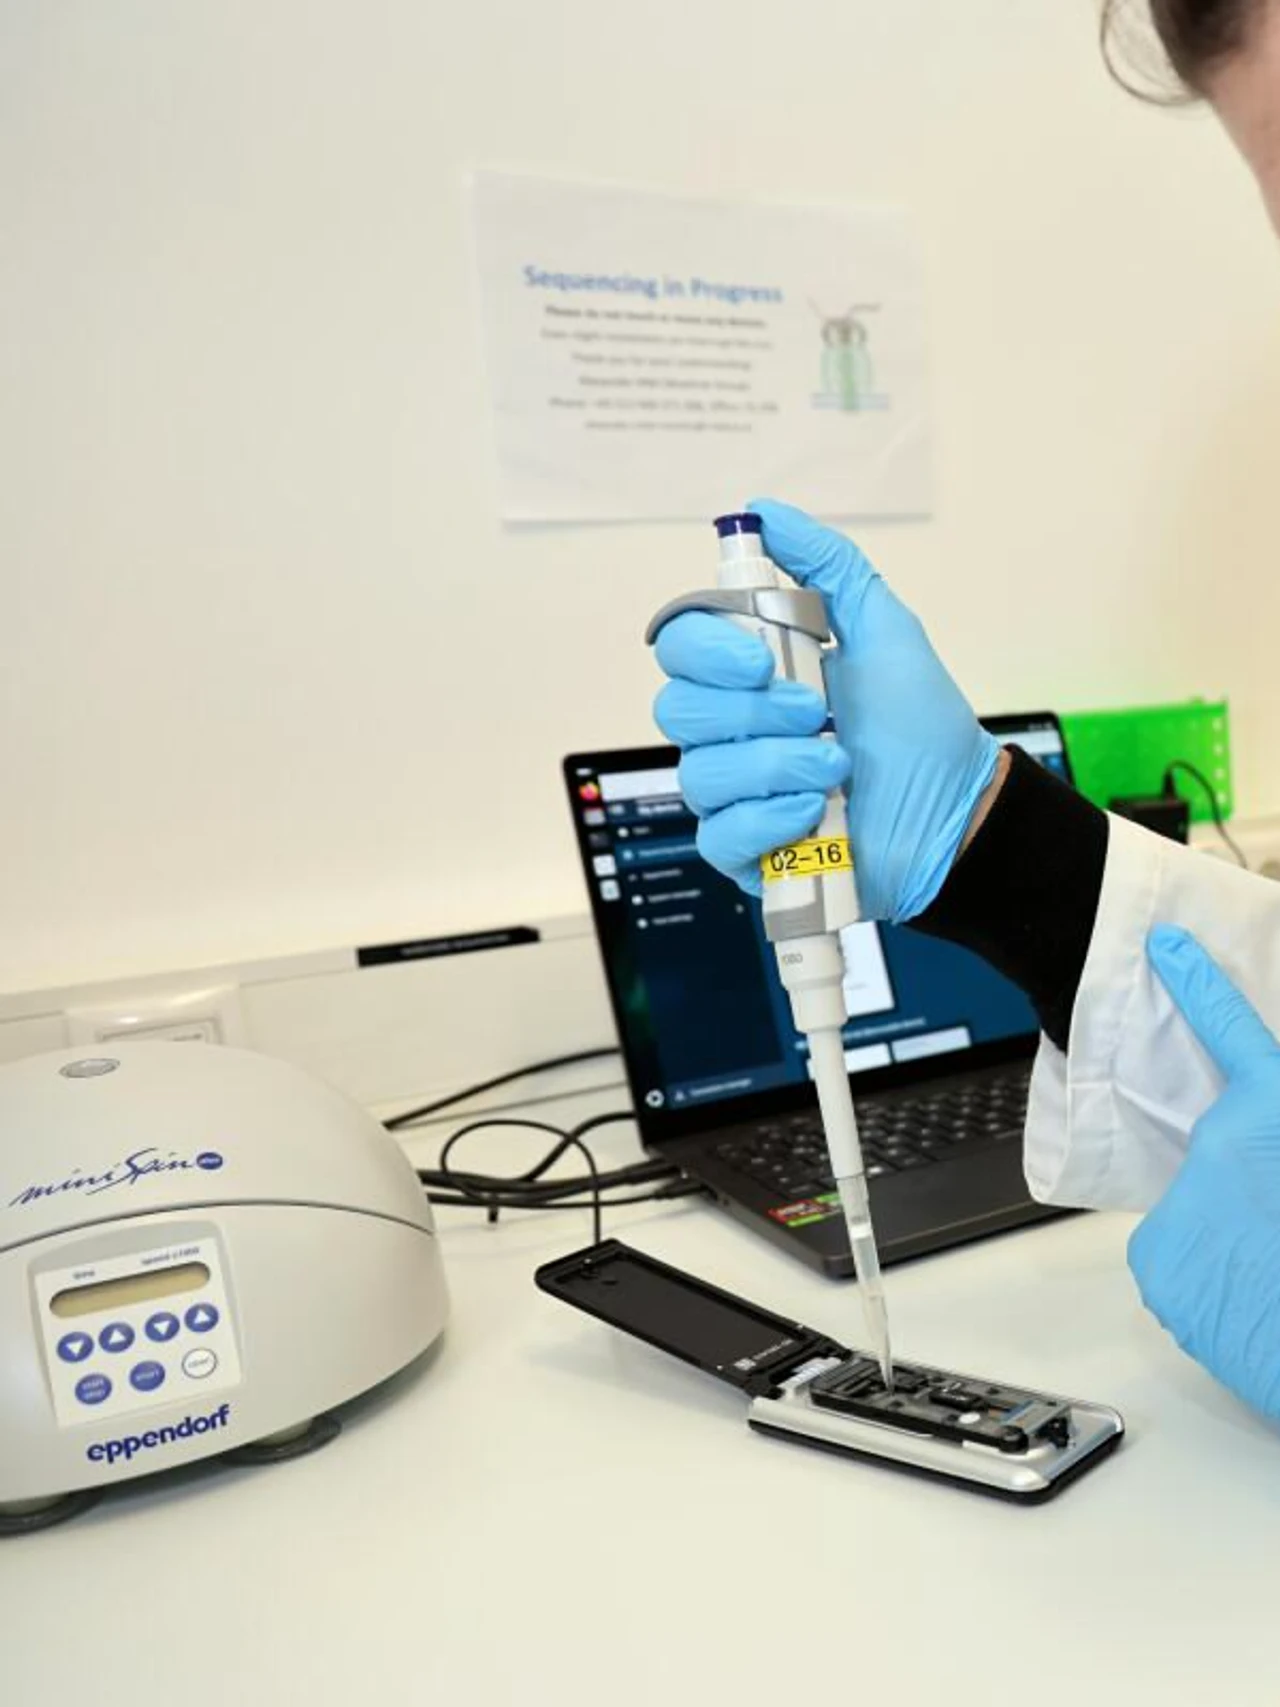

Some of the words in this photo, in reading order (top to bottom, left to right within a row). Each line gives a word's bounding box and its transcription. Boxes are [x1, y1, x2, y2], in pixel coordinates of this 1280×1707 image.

[522, 264, 658, 300] Sequencing
[662, 273, 685, 297] in
[690, 276, 785, 304] Progress
[770, 842, 842, 872] 02-16
[87, 1404, 230, 1464] eppendorf
